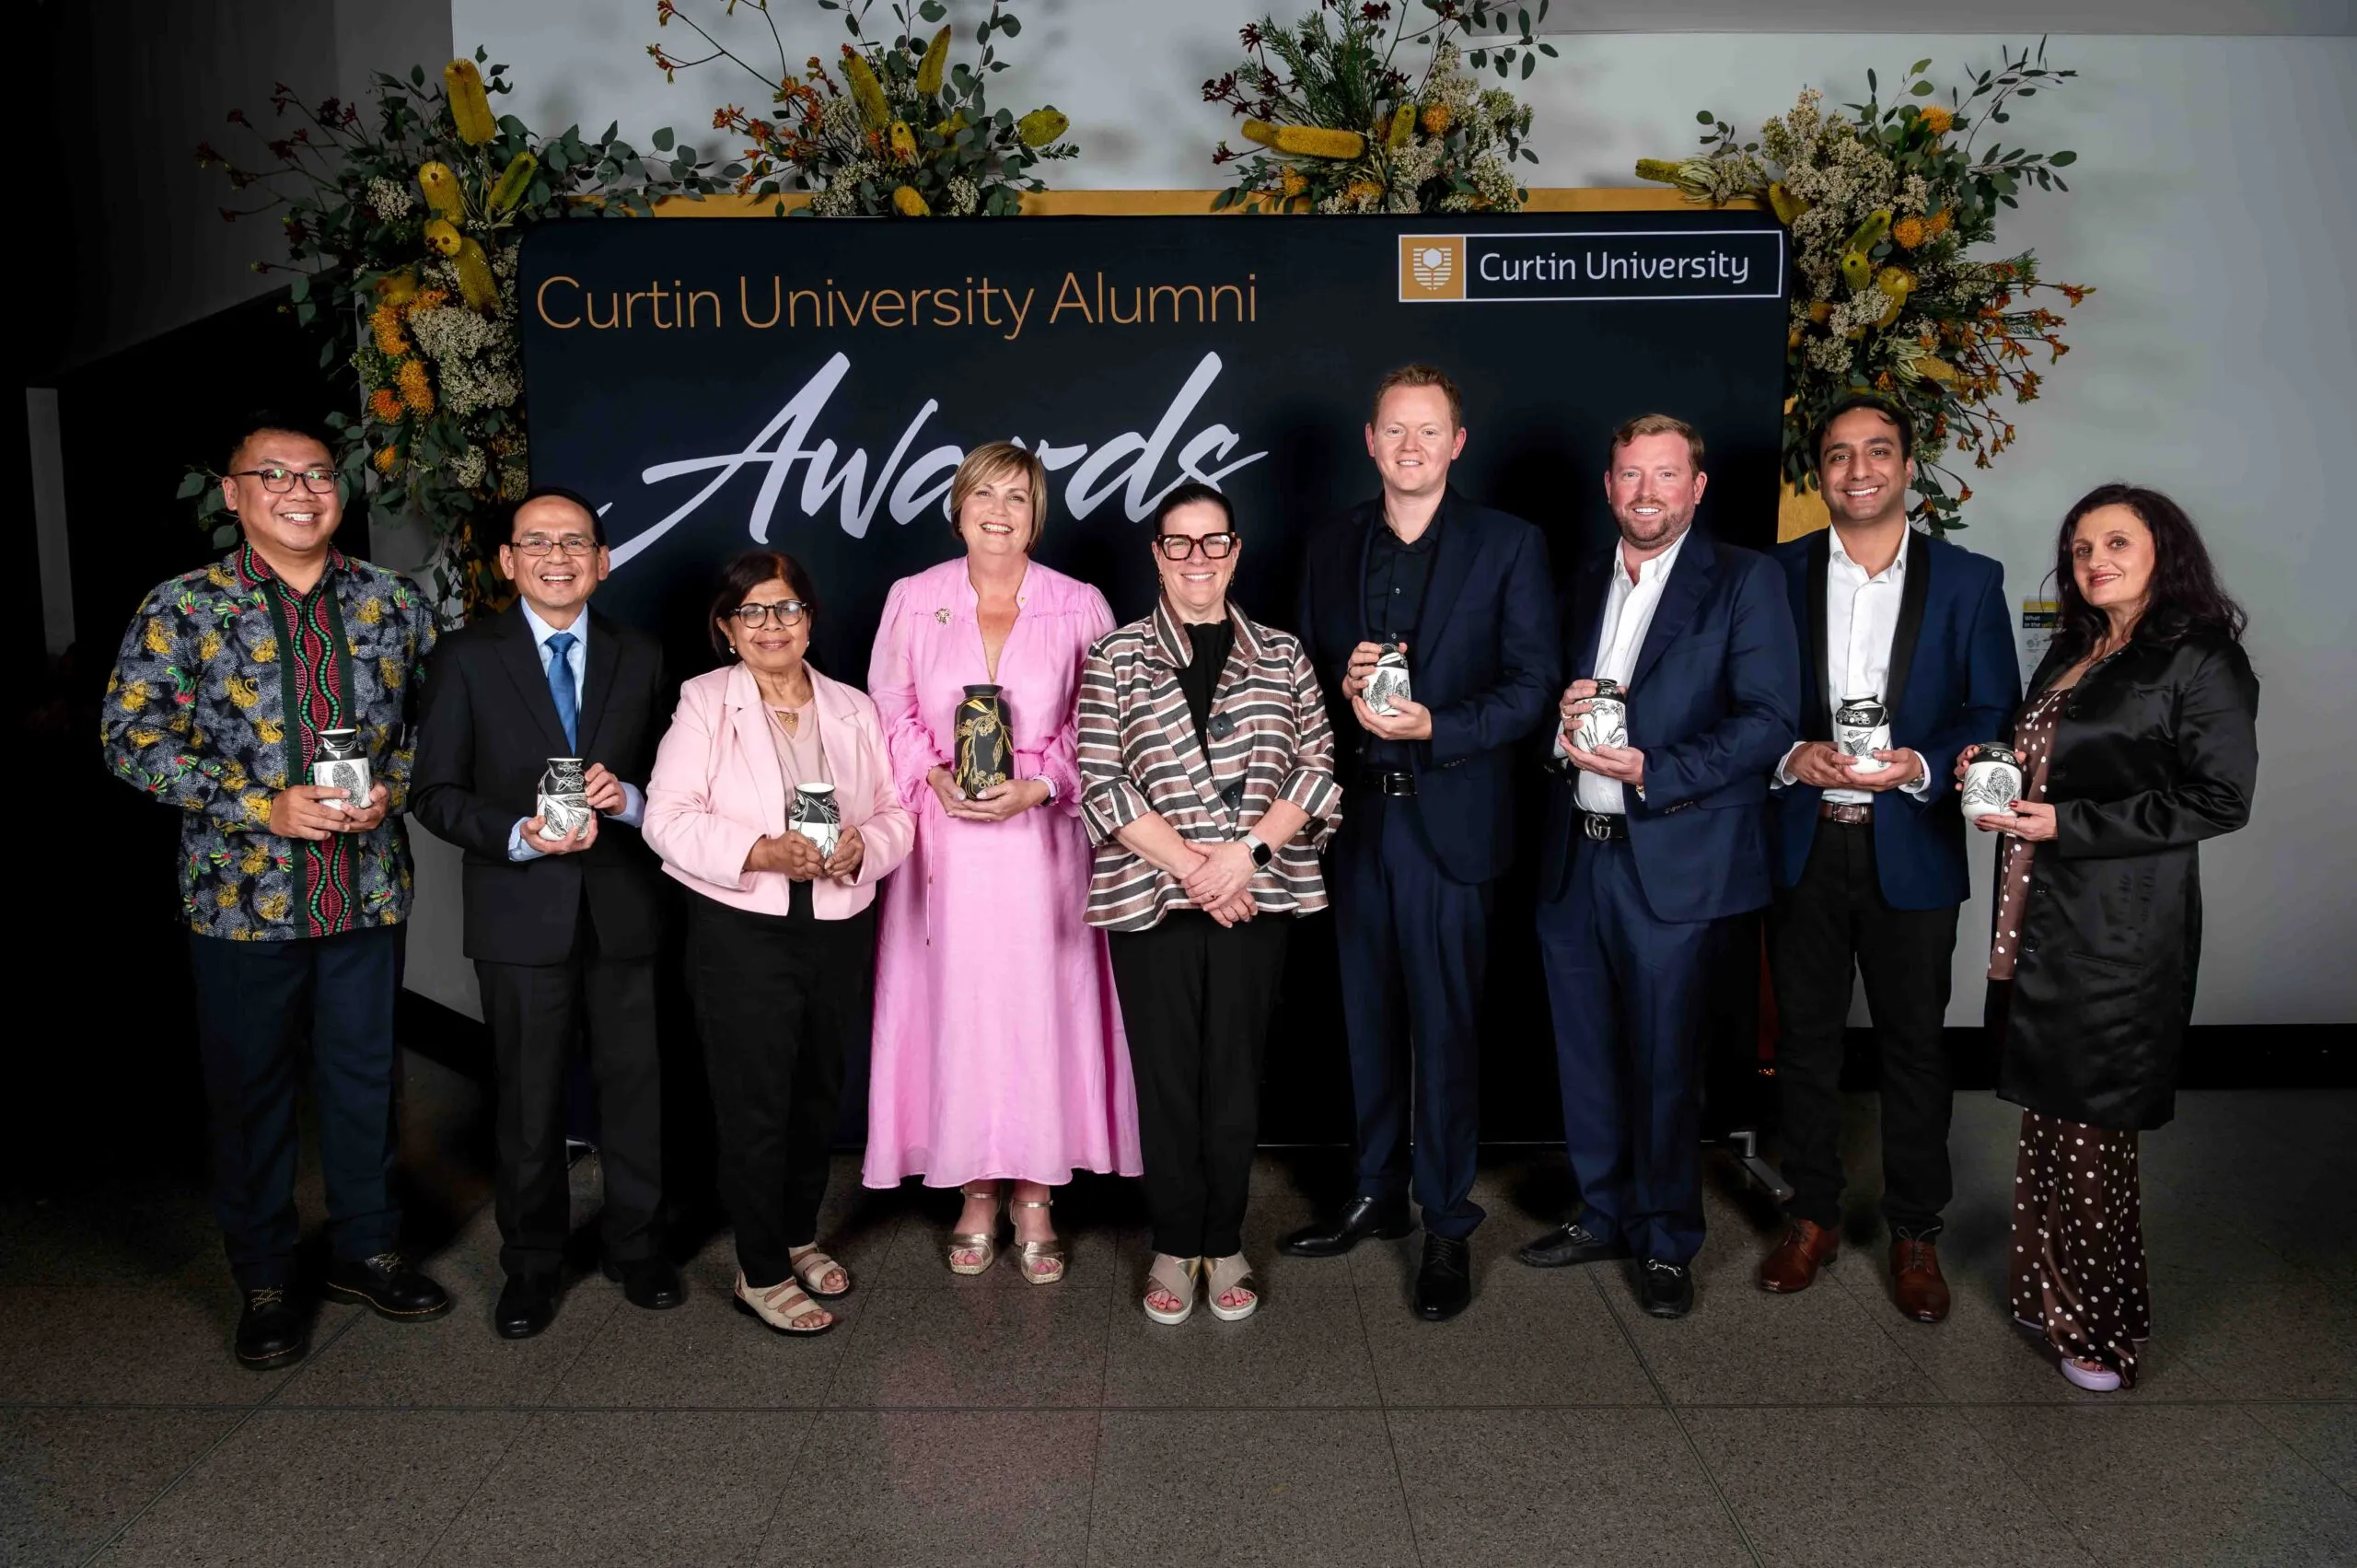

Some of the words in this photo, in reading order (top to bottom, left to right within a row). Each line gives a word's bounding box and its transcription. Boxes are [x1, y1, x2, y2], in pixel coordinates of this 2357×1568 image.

[1480, 251, 1576, 282] Curtin
[1586, 250, 1748, 285] University
[537, 276, 722, 329] Curtin
[739, 276, 1034, 340] University
[1051, 272, 1257, 323] Alumni
